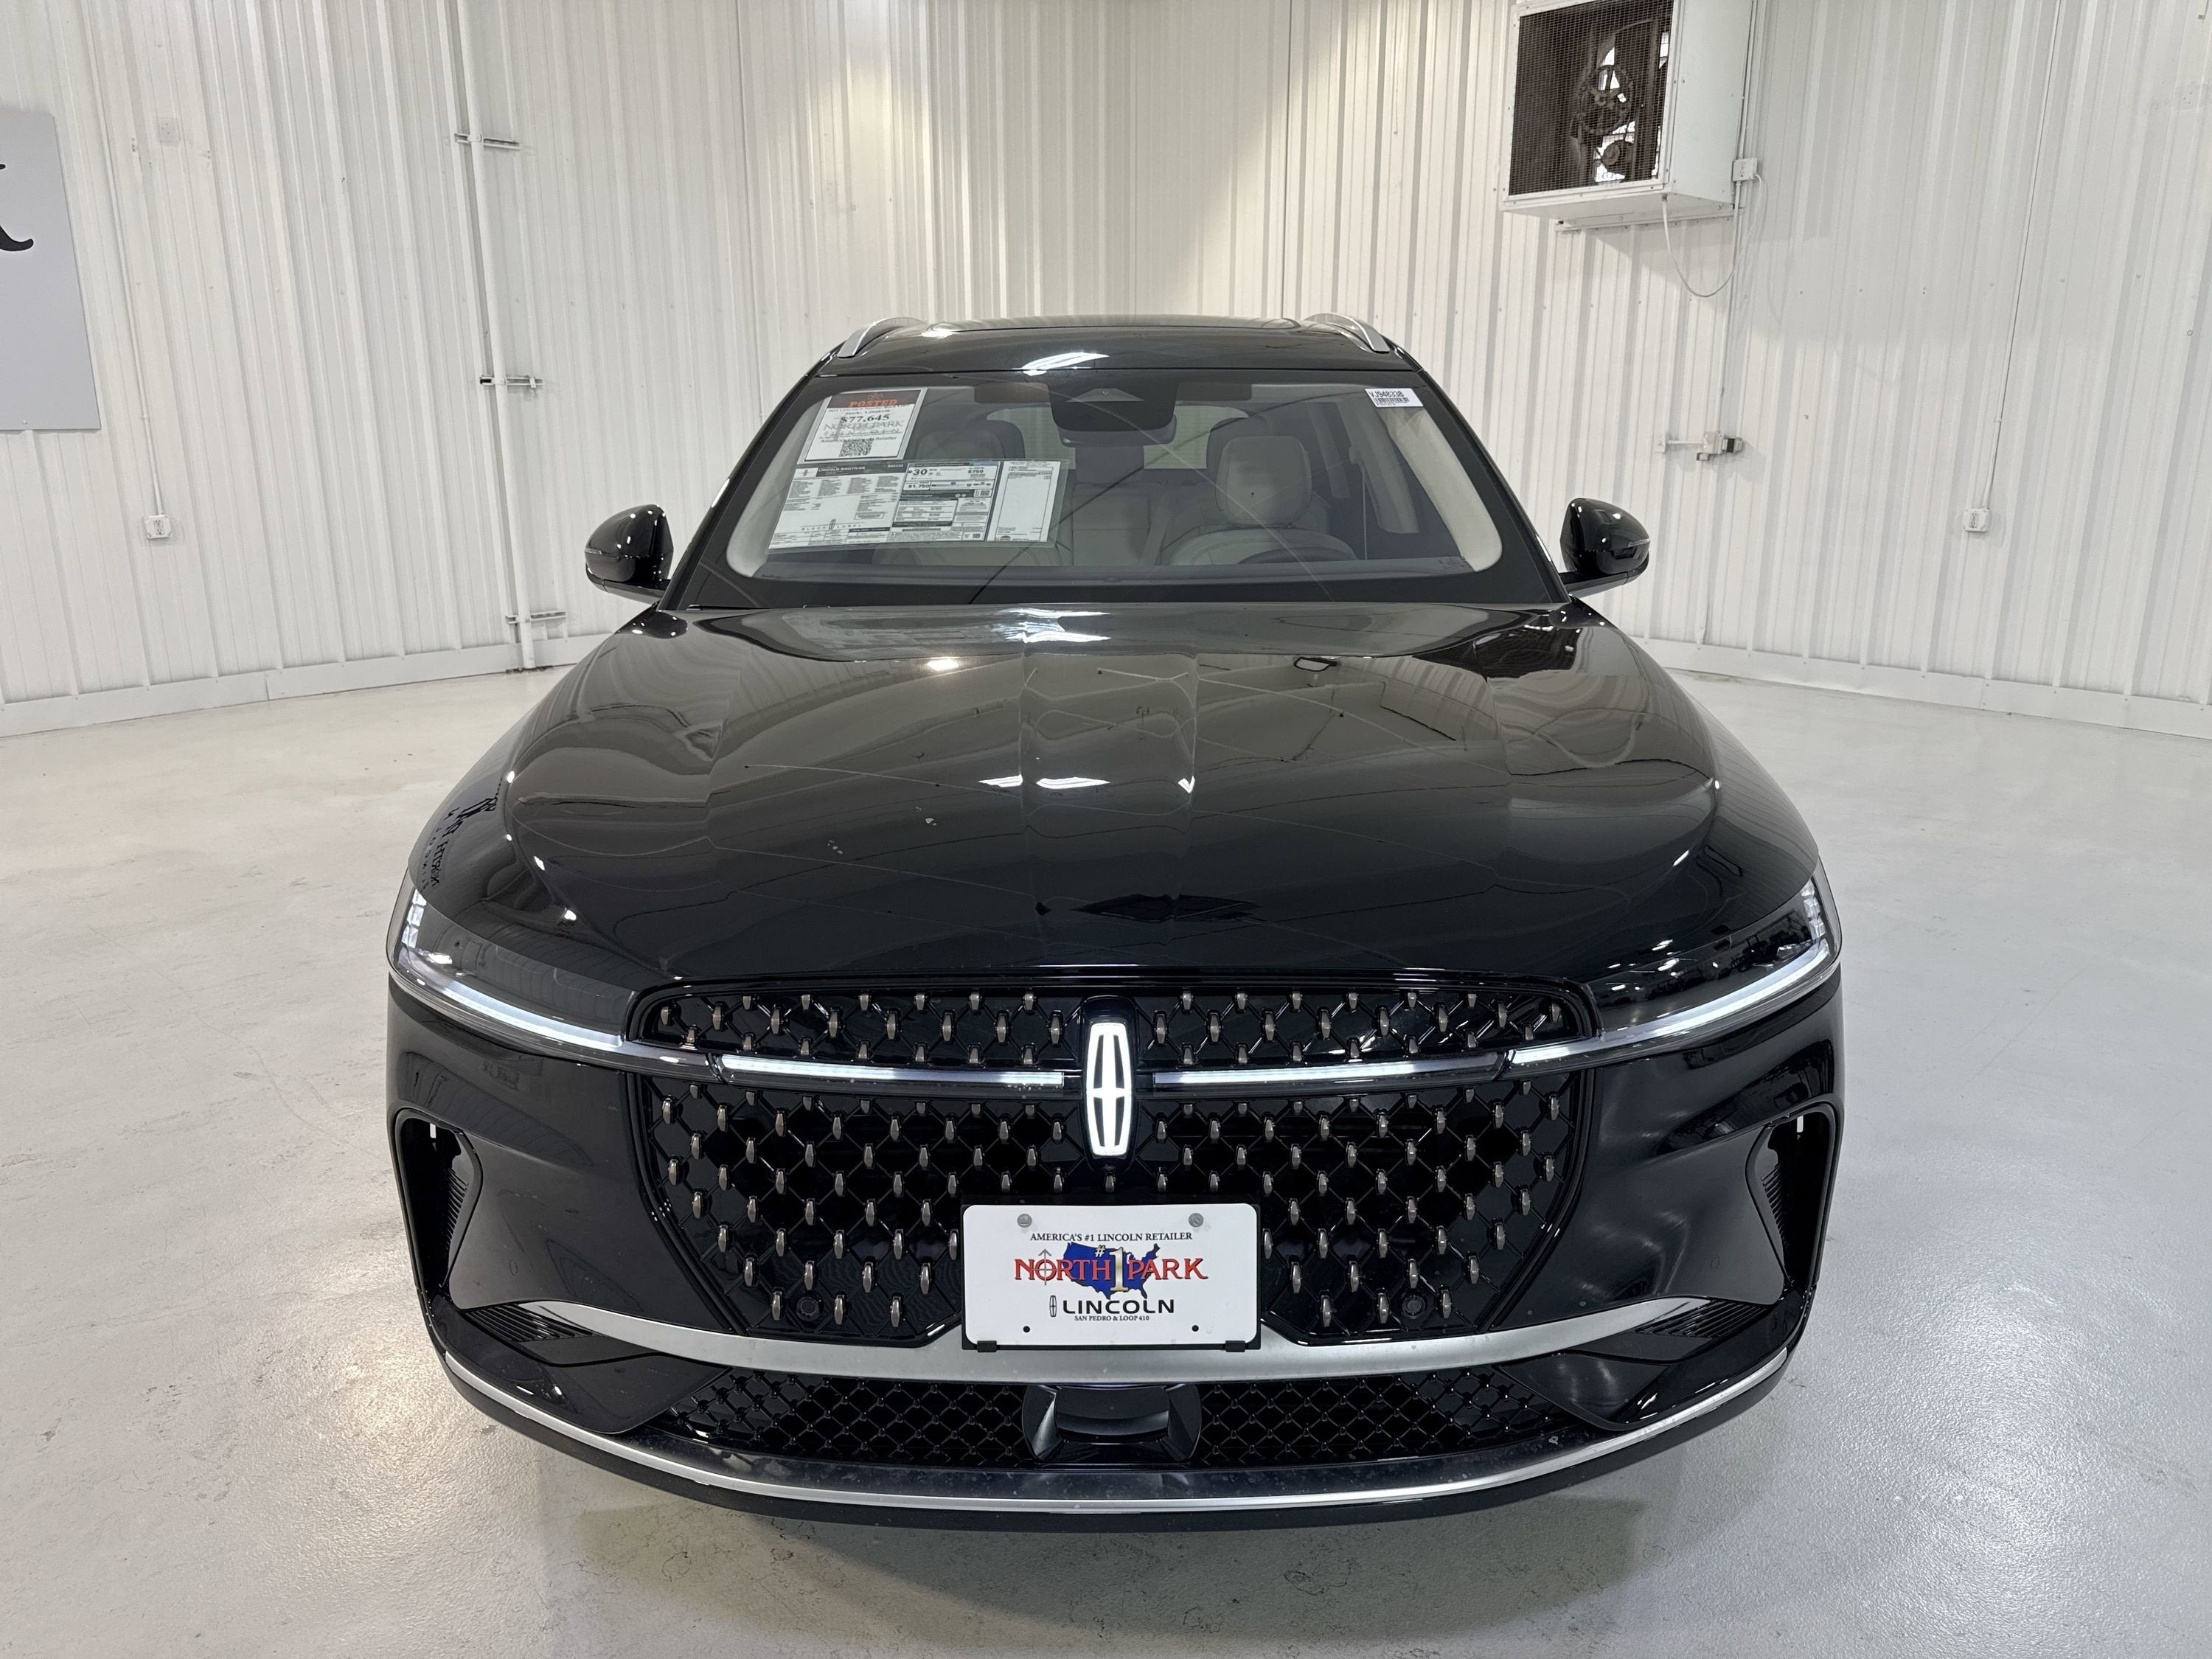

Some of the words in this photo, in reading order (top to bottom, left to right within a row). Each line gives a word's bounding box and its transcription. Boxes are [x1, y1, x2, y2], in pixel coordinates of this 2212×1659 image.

[849, 399, 897, 408] POSTED
[1030, 1233, 1082, 1242] AMERICA'S
[1097, 1234, 1143, 1242] LINCOLN
[1145, 1232, 1193, 1241] RETAILER
[1015, 1259, 1112, 1281] NORTH
[1127, 1258, 1208, 1281] PARK
[1063, 1299, 1174, 1314] LINCOLN
